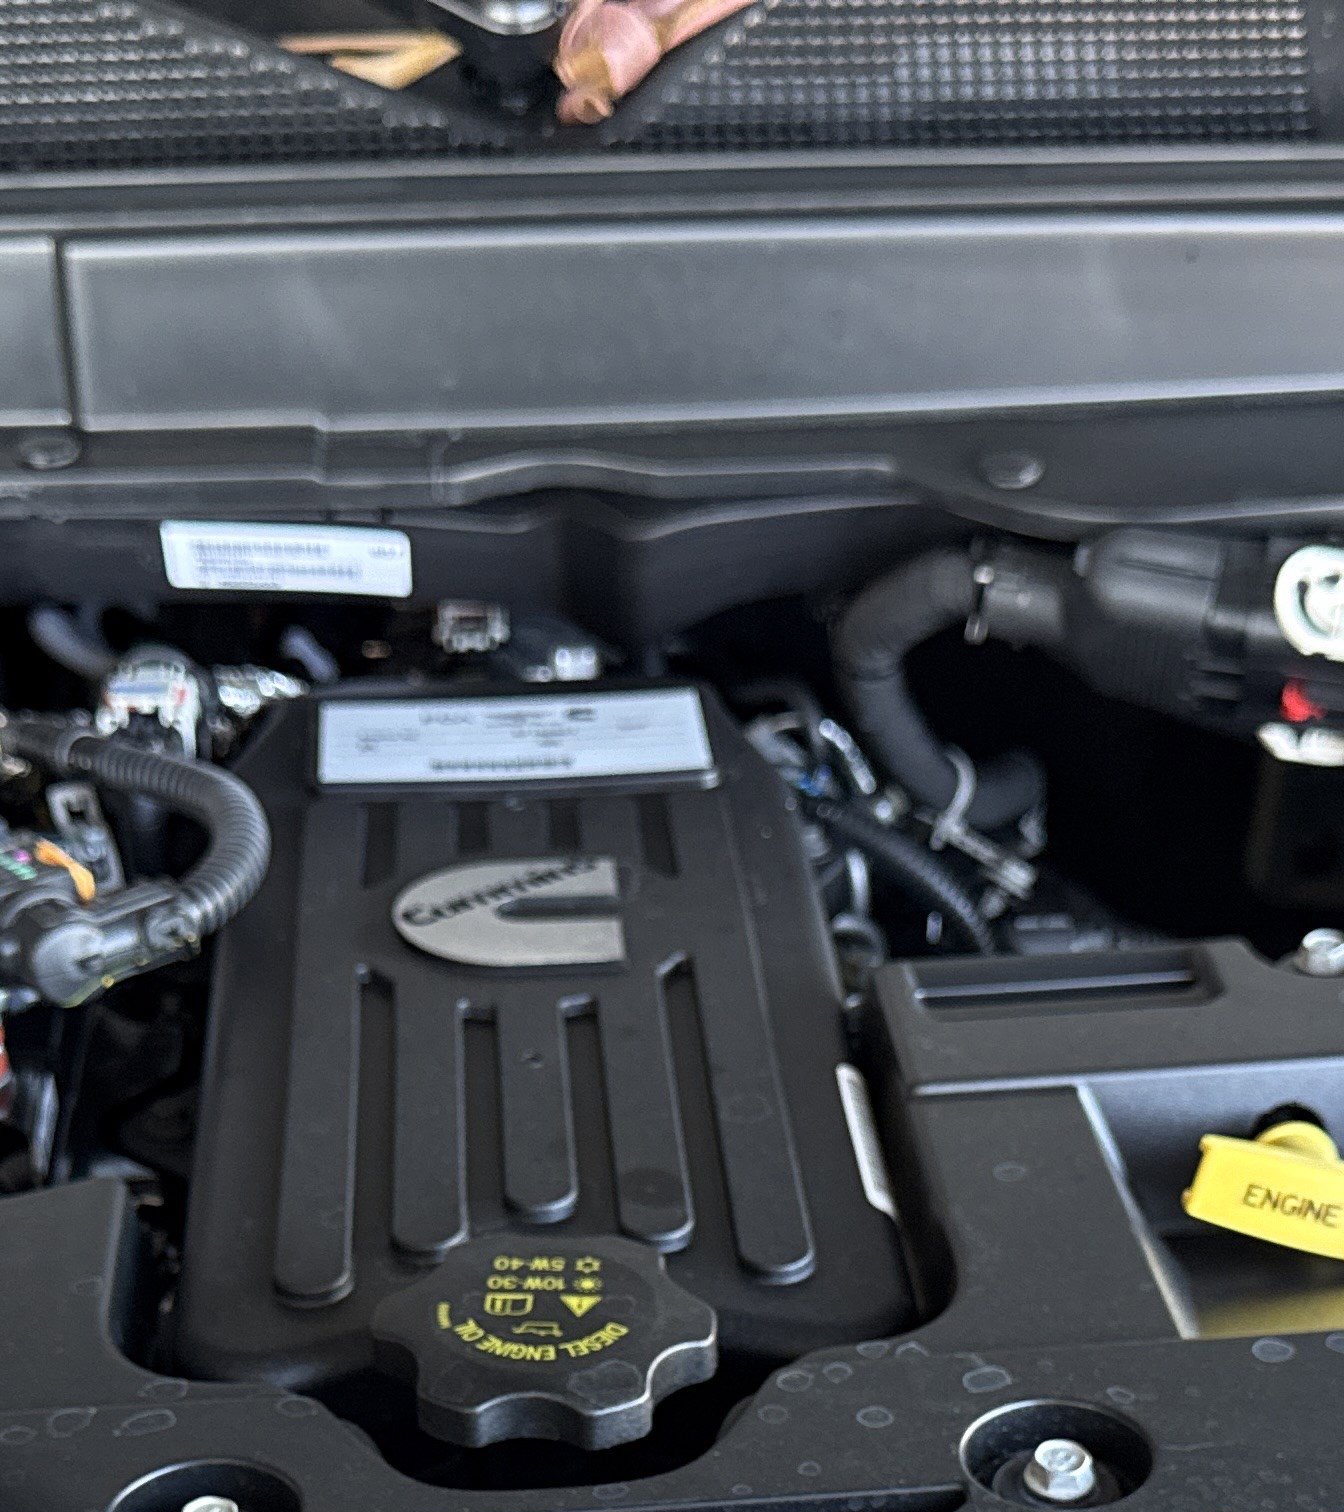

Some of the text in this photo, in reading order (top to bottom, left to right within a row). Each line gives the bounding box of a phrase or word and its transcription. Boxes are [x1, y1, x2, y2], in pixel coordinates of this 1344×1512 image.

[1242, 1183, 1344, 1229] ENGINE
[493, 1255, 566, 1272] 5W-40
[486, 1274, 566, 1291] 10W-30
[452, 1317, 630, 1362] DIESEL ENGINE OIL
